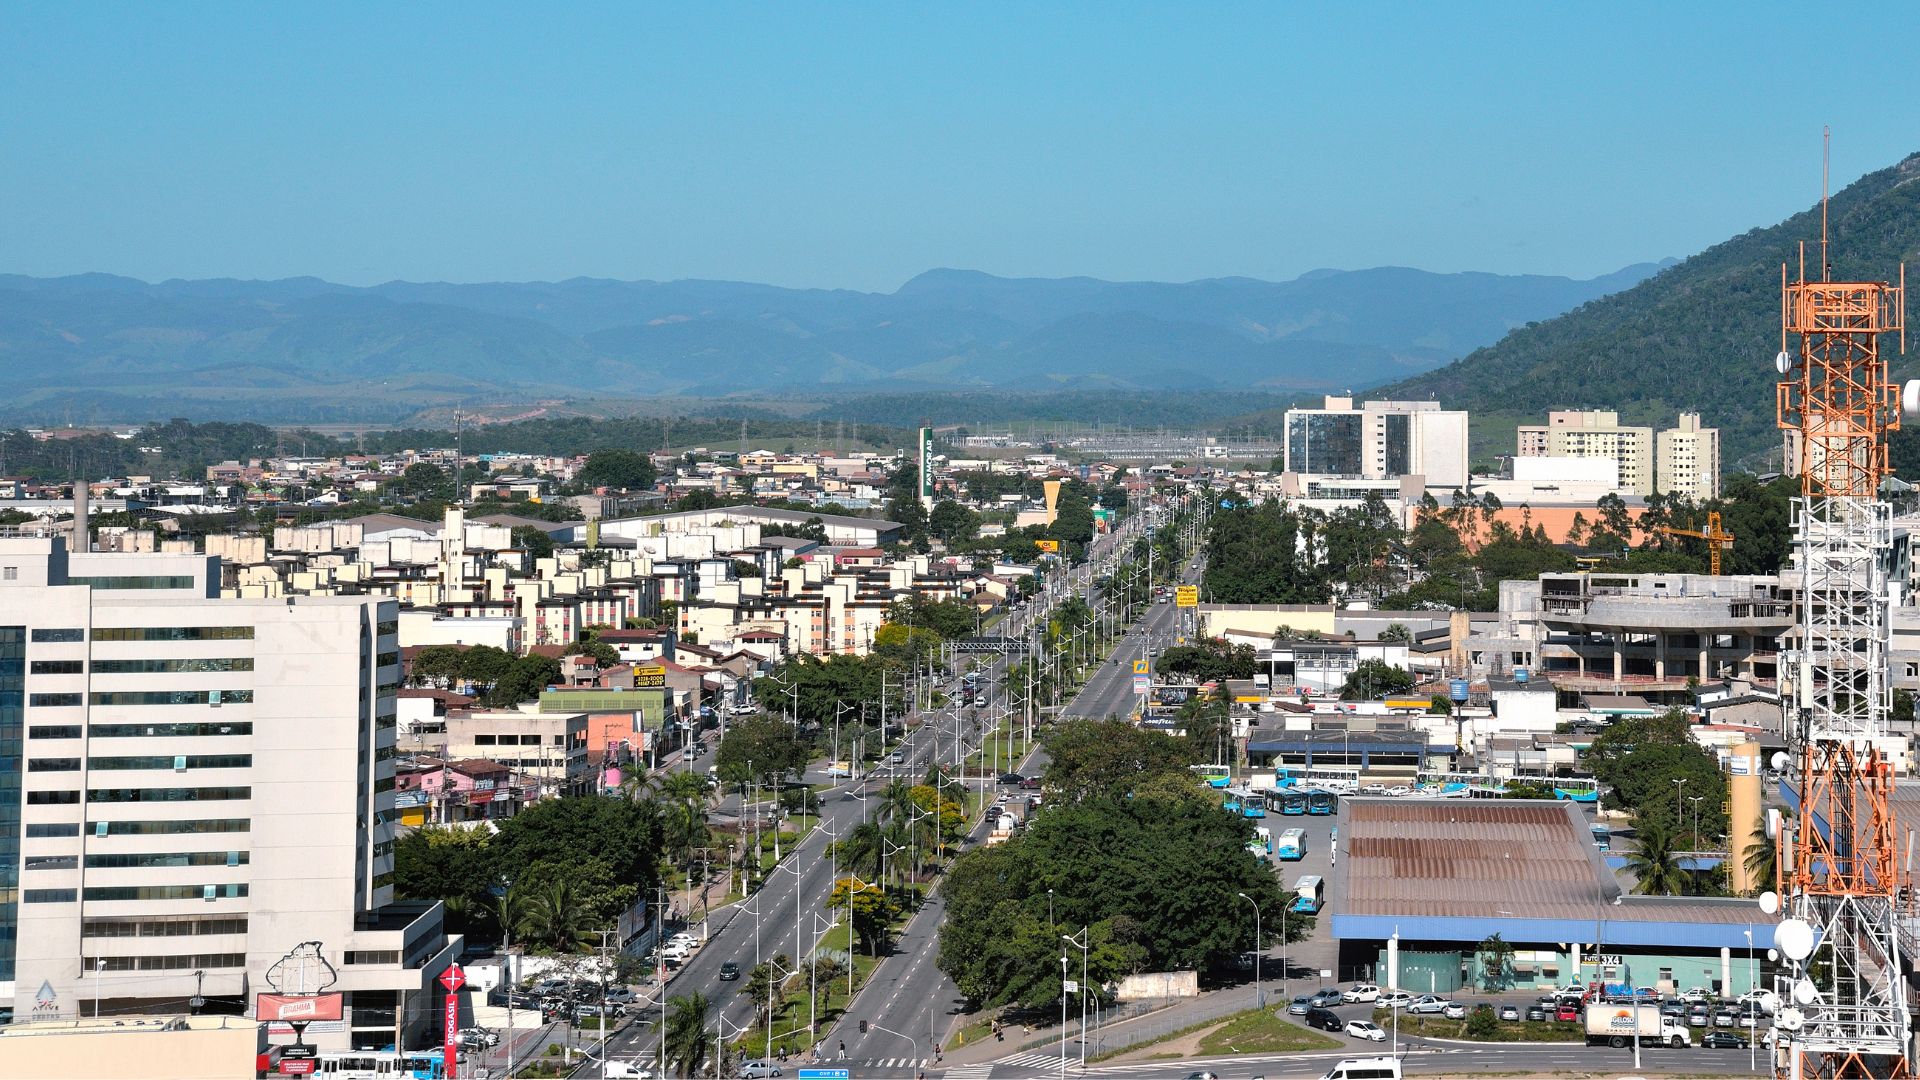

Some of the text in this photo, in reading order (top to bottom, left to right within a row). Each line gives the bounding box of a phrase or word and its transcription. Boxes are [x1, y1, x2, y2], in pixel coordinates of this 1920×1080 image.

[1601, 956, 1619, 965] 3X4
[283, 1002, 311, 1014] BRAHMA
[447, 1001, 455, 1046] DROGASIL
